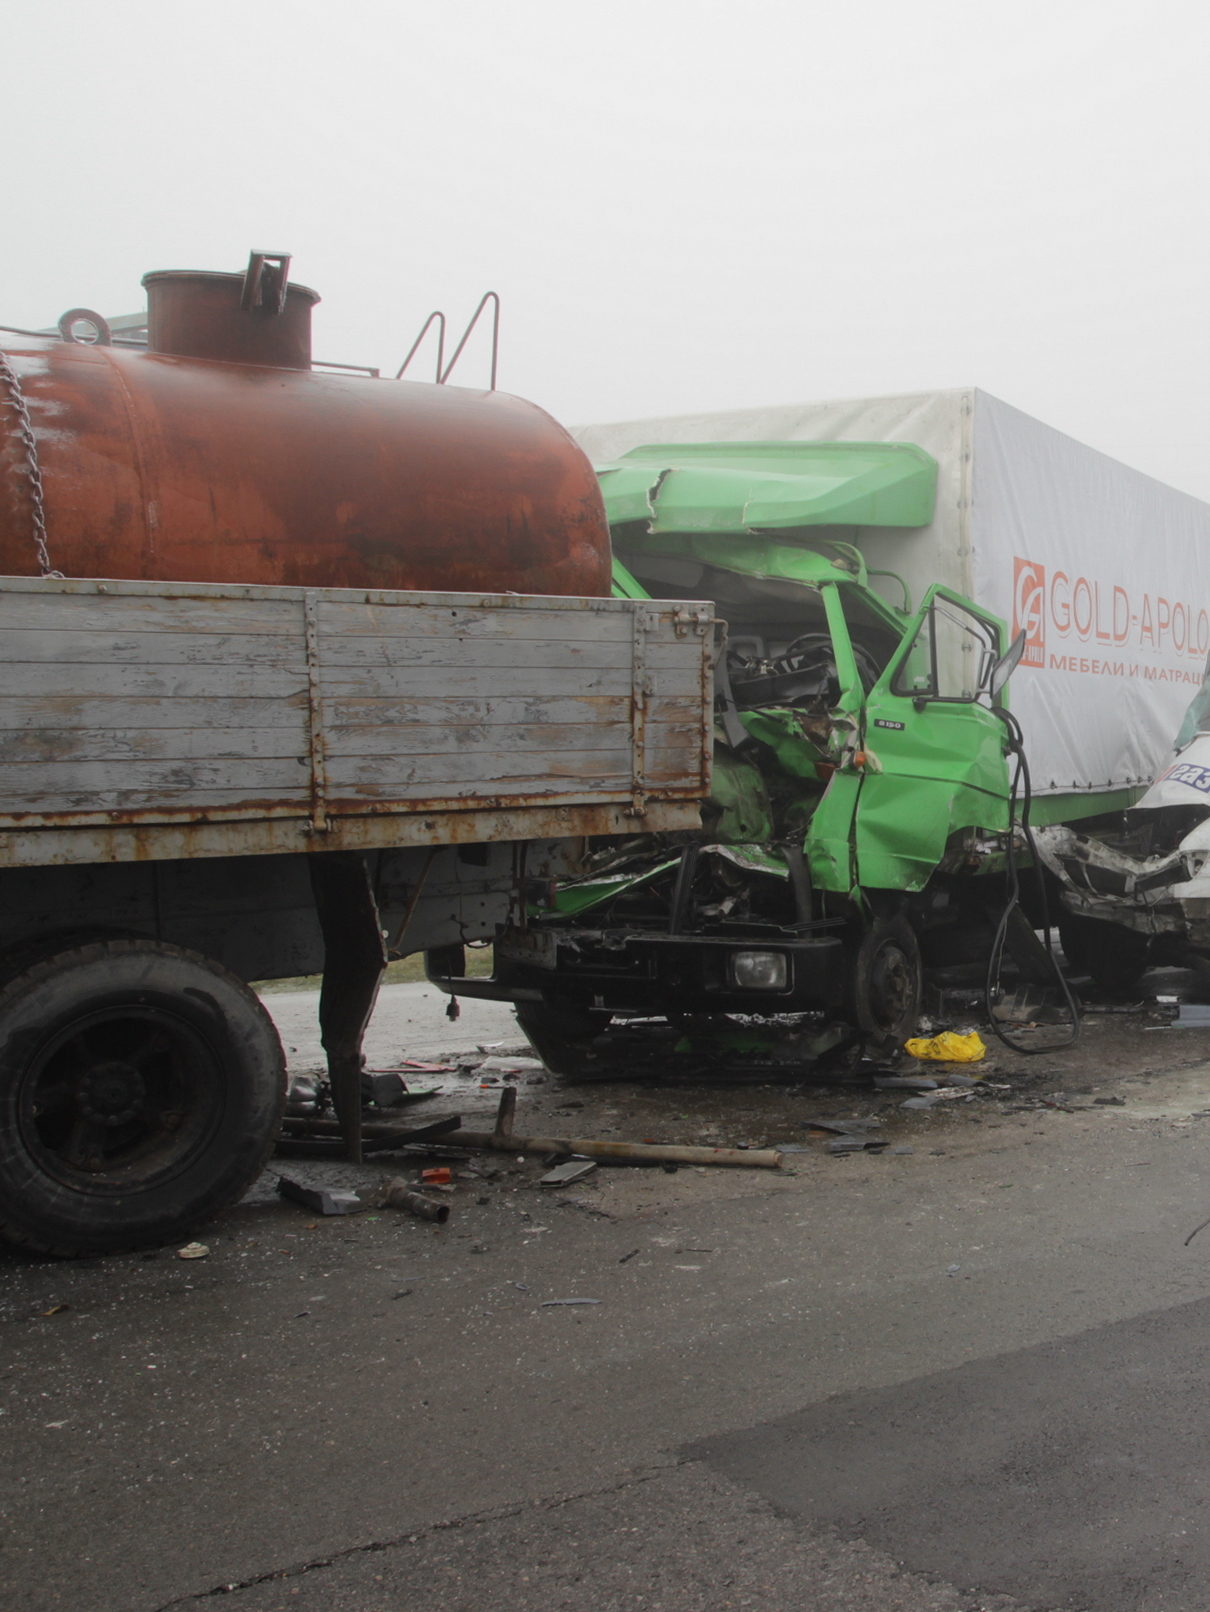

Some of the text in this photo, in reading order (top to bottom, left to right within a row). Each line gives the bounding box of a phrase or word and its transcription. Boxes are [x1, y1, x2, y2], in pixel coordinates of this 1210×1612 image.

[1051, 570, 1209, 657] GOLD-APOLO
[1049, 654, 1124, 677] МЕБЕЛИ
[1129, 663, 1139, 678] И
